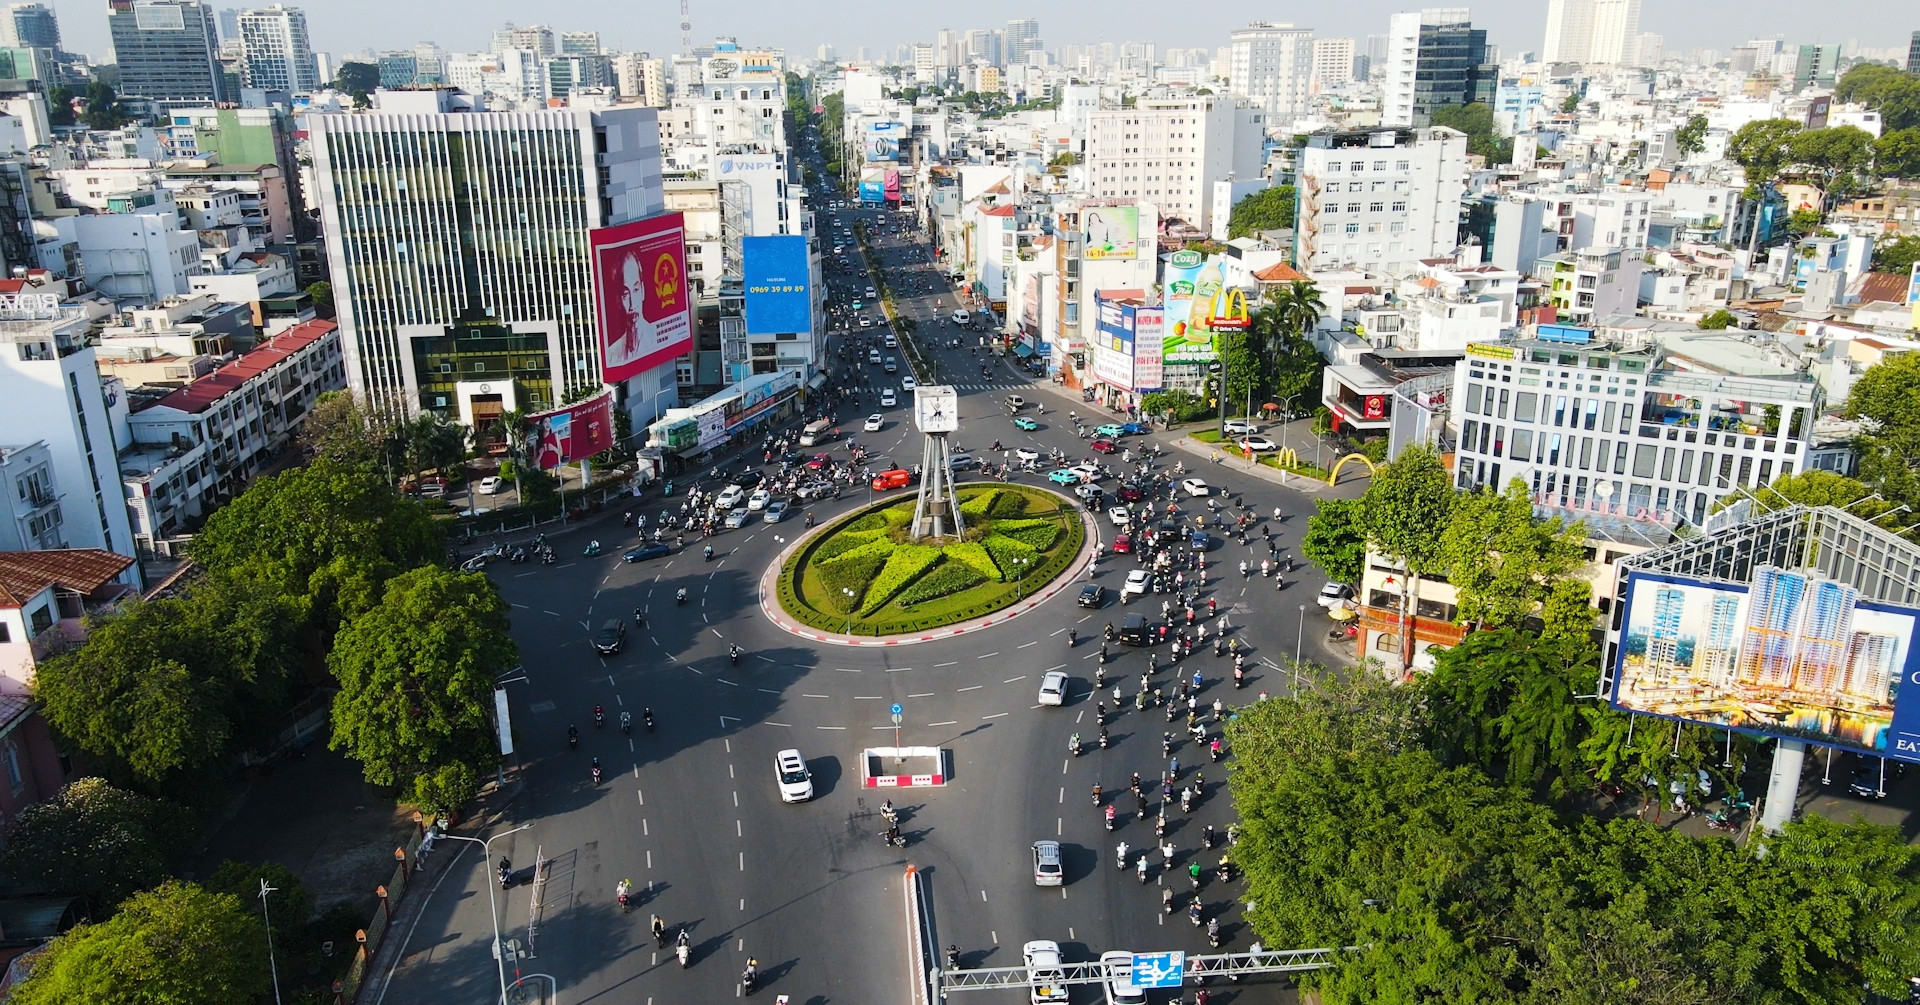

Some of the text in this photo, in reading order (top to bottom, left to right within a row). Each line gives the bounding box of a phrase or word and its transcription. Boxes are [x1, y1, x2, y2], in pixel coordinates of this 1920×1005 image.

[736, 162, 773, 170] VNPT
[1173, 254, 1198, 265] Cozy
[783, 285, 793, 293] 89
